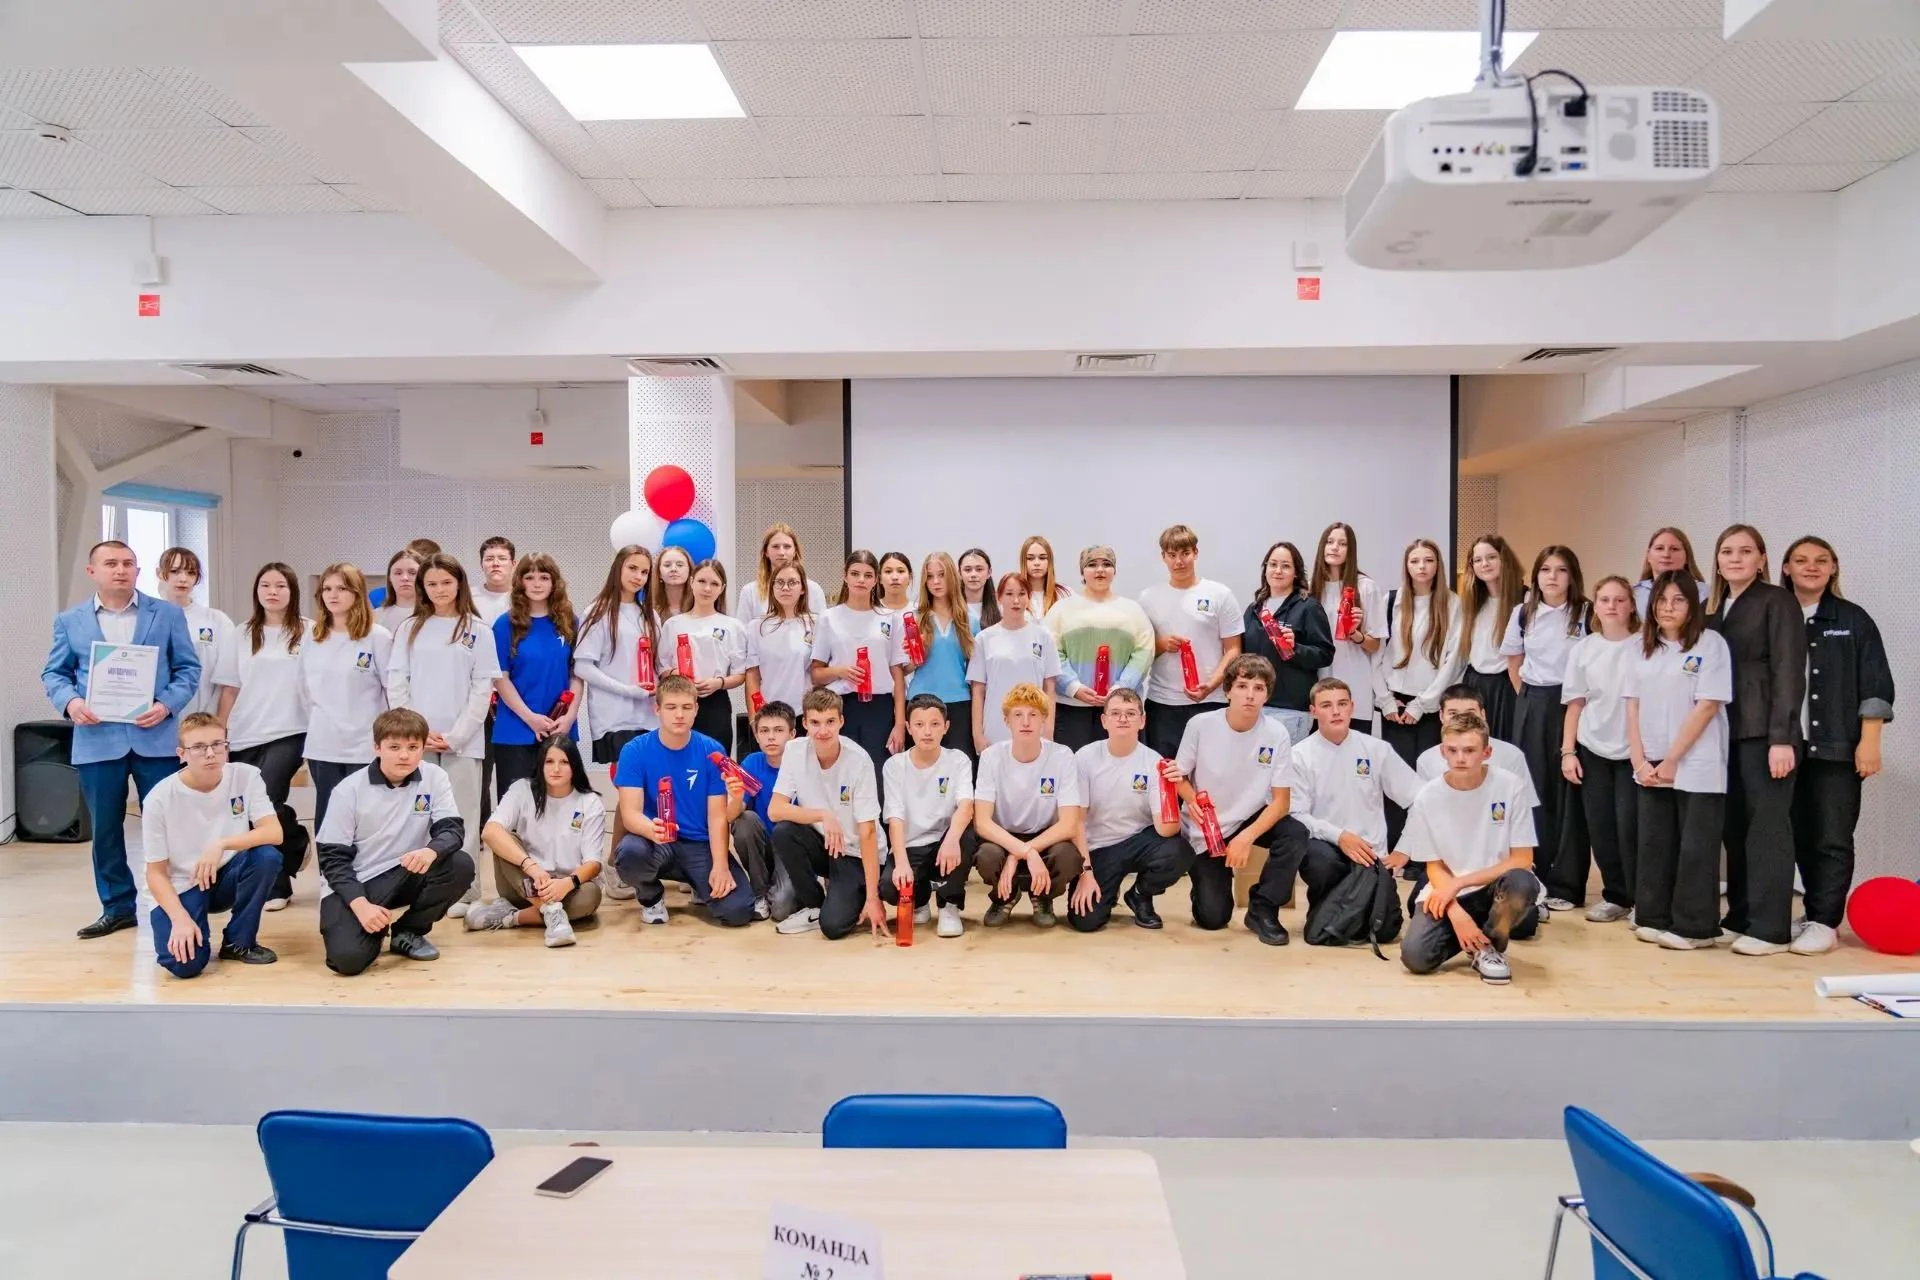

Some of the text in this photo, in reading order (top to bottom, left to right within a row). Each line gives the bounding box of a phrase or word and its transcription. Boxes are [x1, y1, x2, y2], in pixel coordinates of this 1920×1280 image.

[773, 1224, 870, 1265] КОМАНДА
[800, 1262, 834, 1280] № 2
